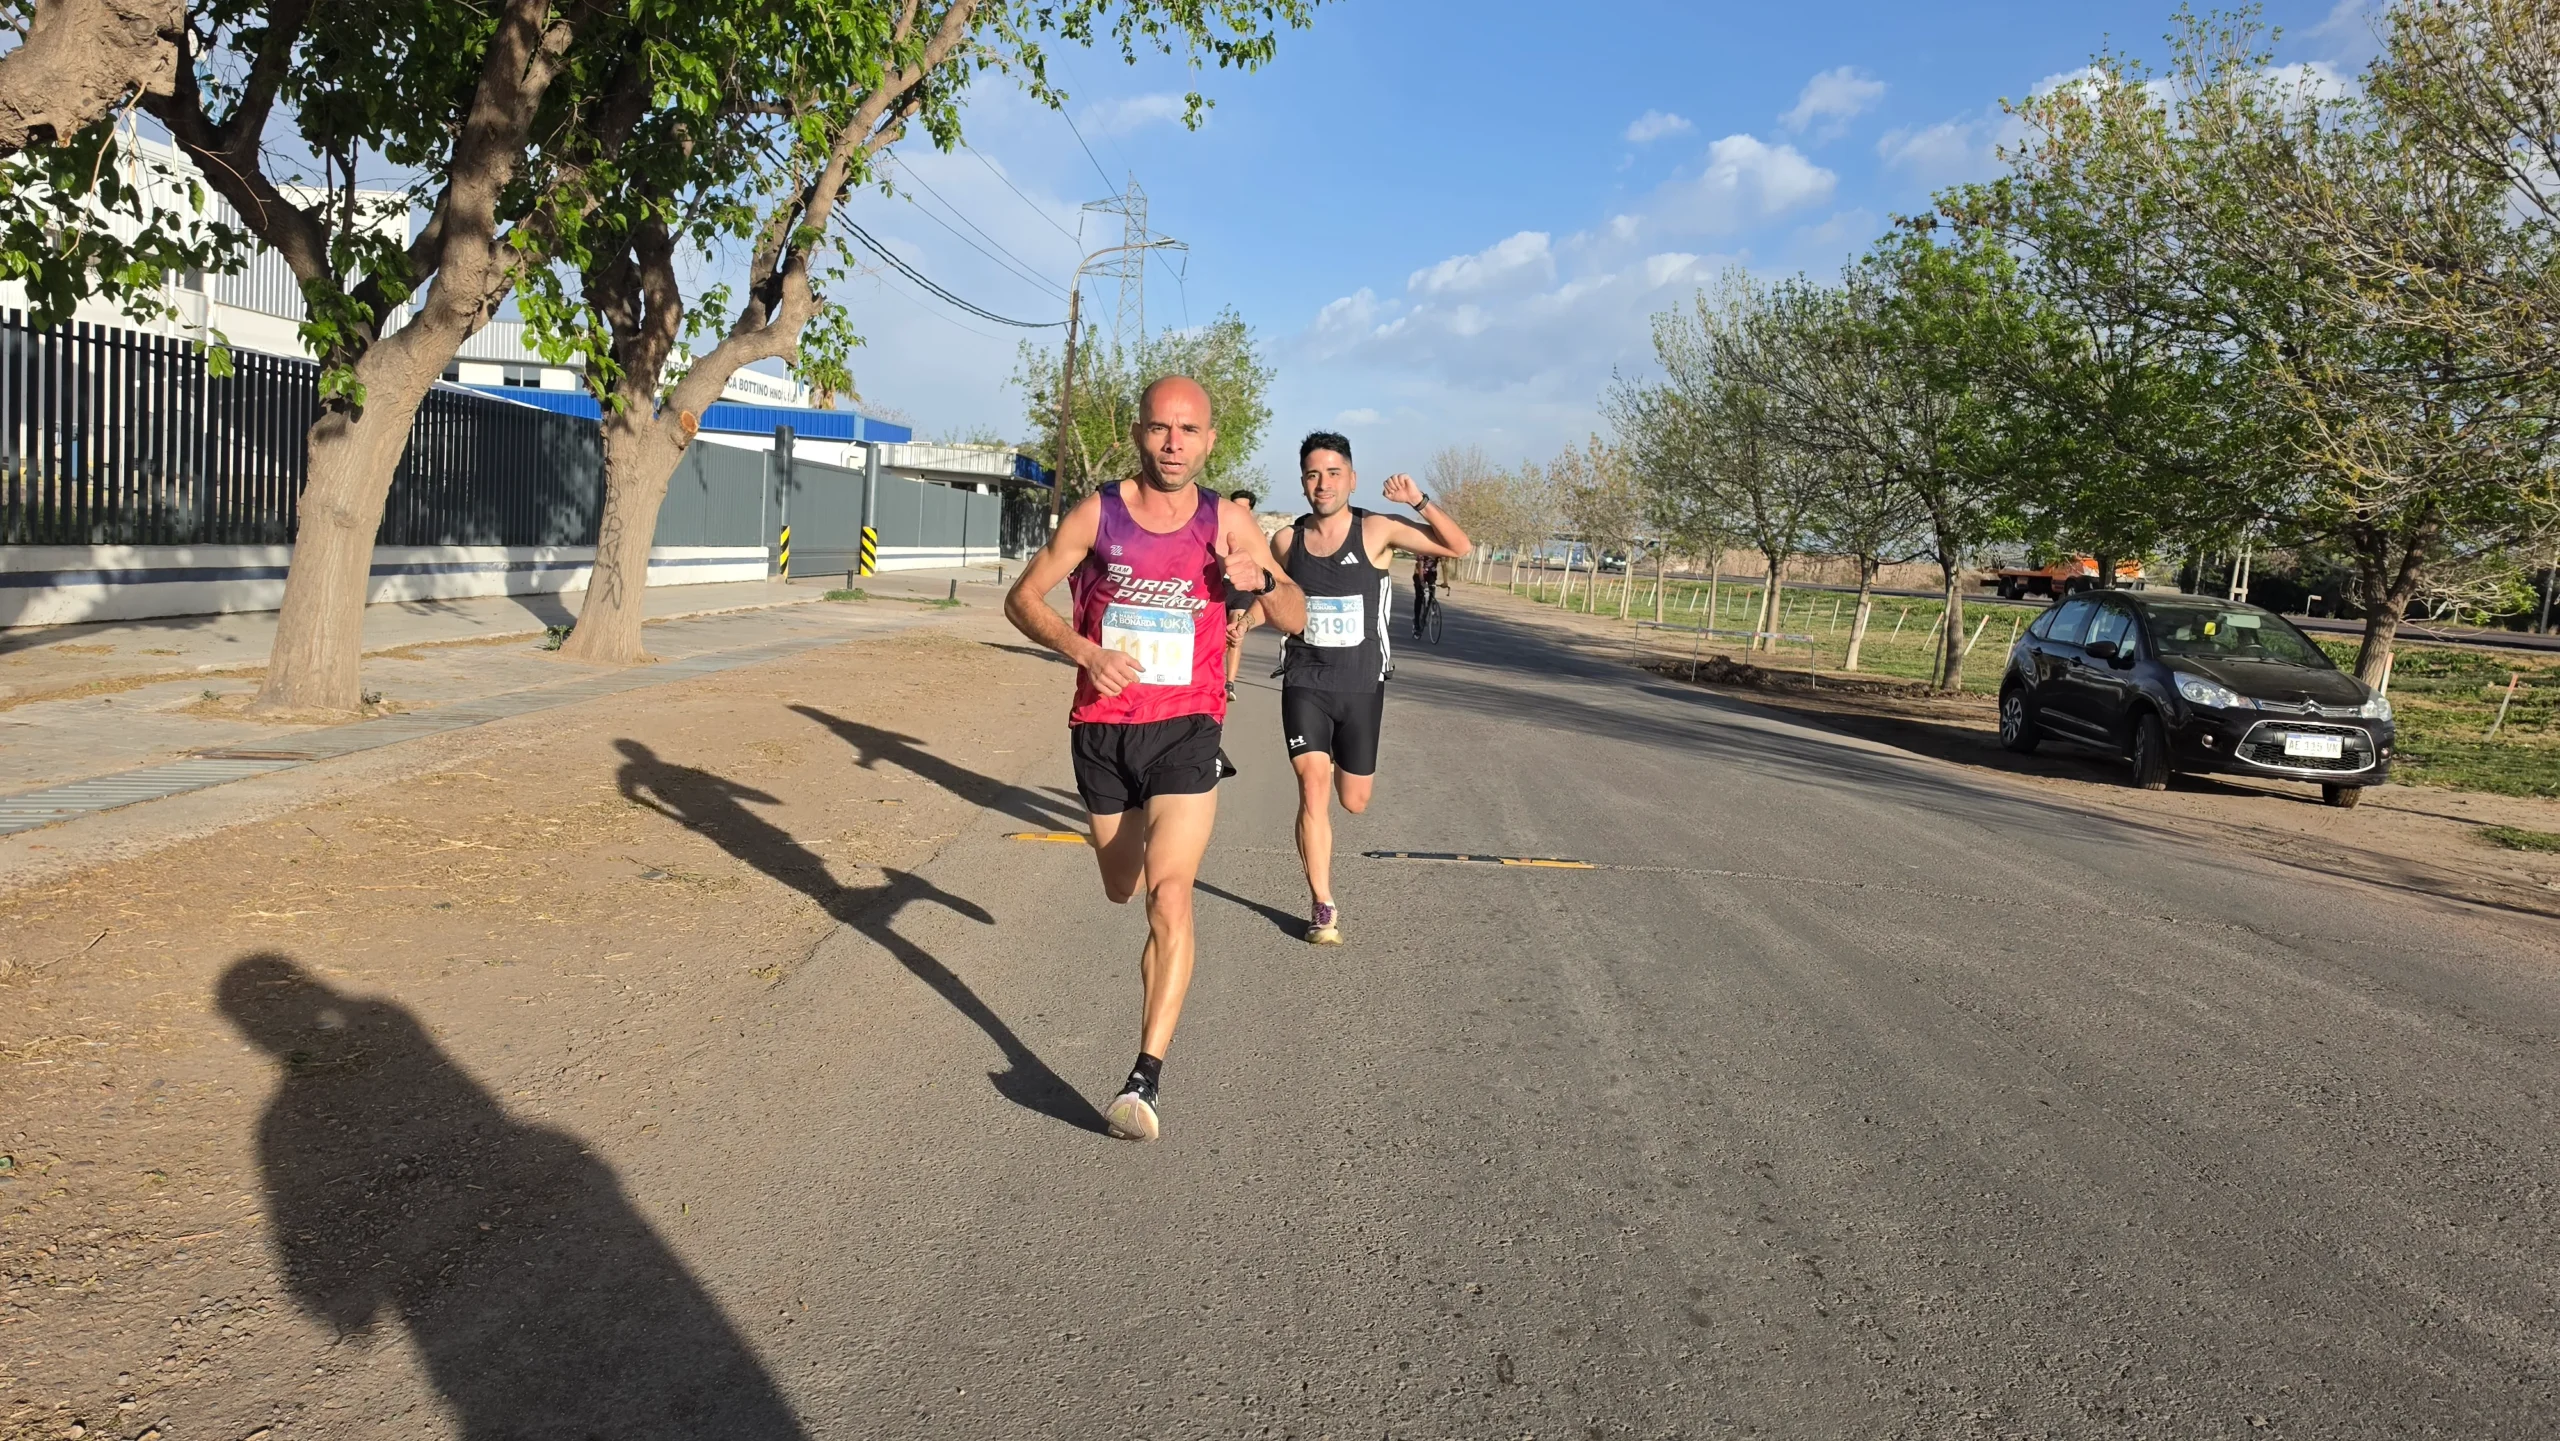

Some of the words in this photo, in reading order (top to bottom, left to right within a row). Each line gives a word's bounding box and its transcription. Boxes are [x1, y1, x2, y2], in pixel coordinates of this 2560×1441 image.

[739, 378, 769, 397] BOTTINO
[1108, 564, 1129, 573] TEAM
[1107, 573, 1180, 593] PURA
[1119, 617, 1157, 628] BONARDA
[1159, 617, 1181, 629] 10K
[1309, 617, 1356, 635] 5190
